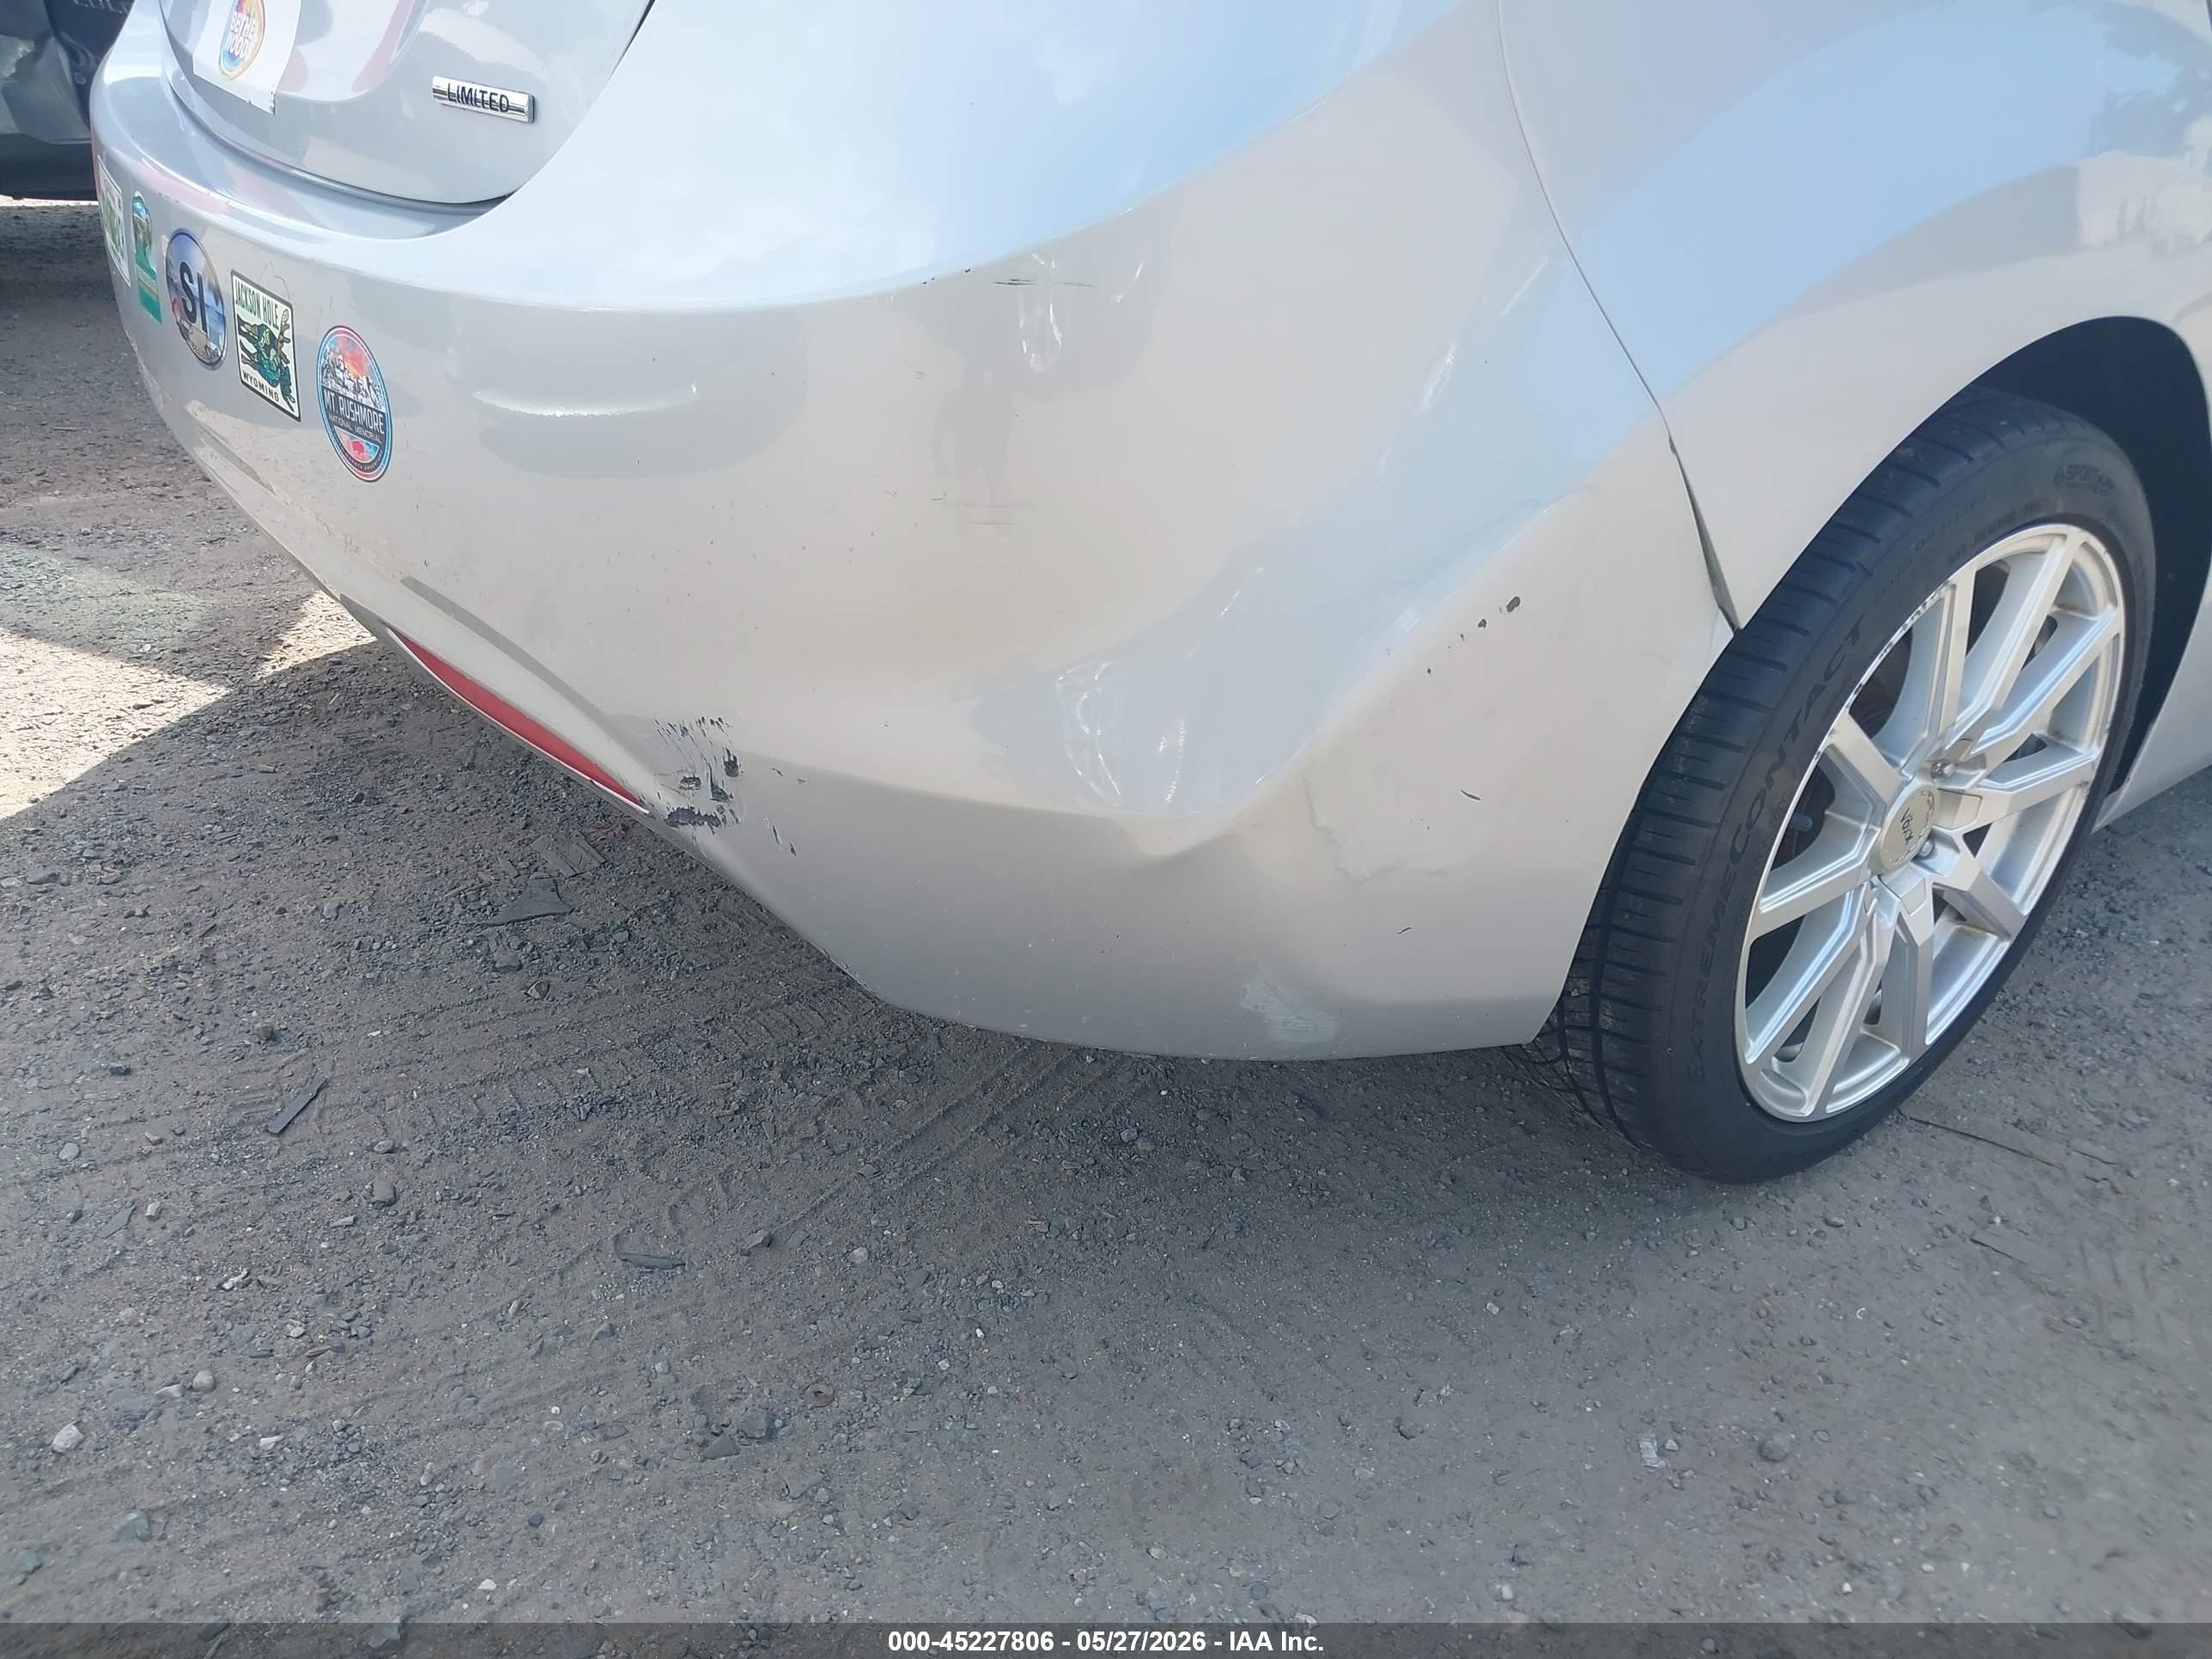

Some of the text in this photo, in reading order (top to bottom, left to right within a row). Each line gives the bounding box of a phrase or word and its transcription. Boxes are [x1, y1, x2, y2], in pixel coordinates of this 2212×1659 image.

[447, 82, 510, 113] LIMITED
[179, 261, 208, 332] SI
[234, 278, 279, 331] JACKSON HOLE
[242, 370, 280, 403] WYOMING
[324, 389, 386, 435] MT. RUSHMORE
